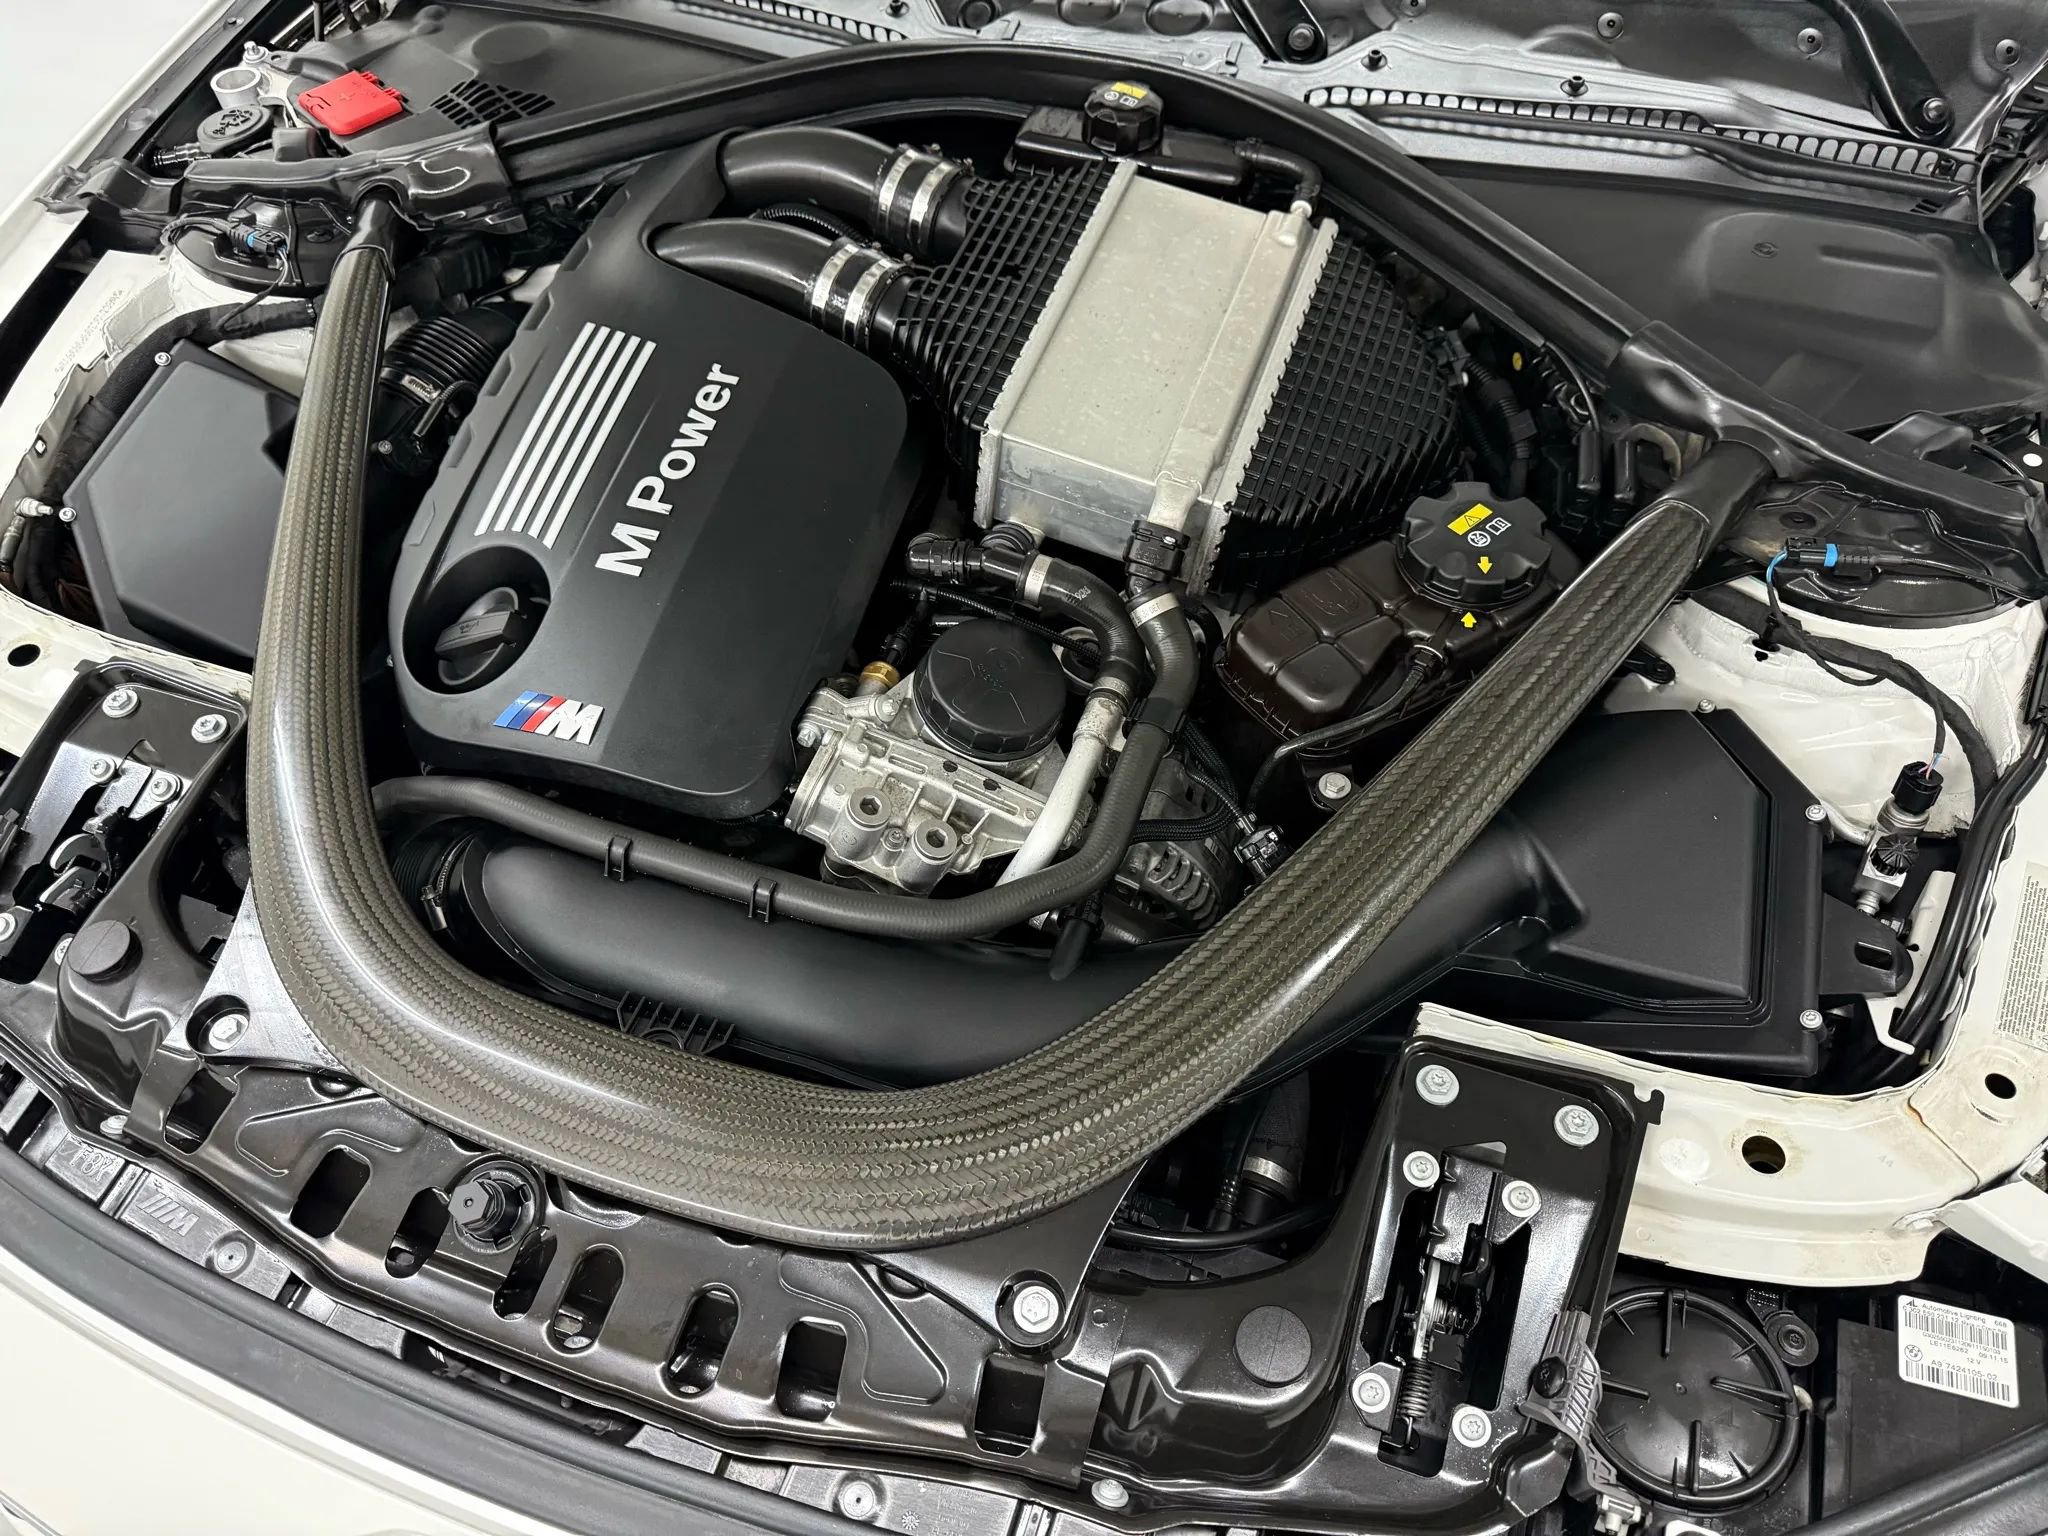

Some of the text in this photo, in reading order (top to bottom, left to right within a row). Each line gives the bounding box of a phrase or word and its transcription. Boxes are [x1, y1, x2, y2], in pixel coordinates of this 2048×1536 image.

[595, 363, 740, 577] M Power
[533, 699, 605, 745] M
[1922, 1303, 1958, 1317] Automotive
[1960, 1312, 1986, 1324] Lighting
